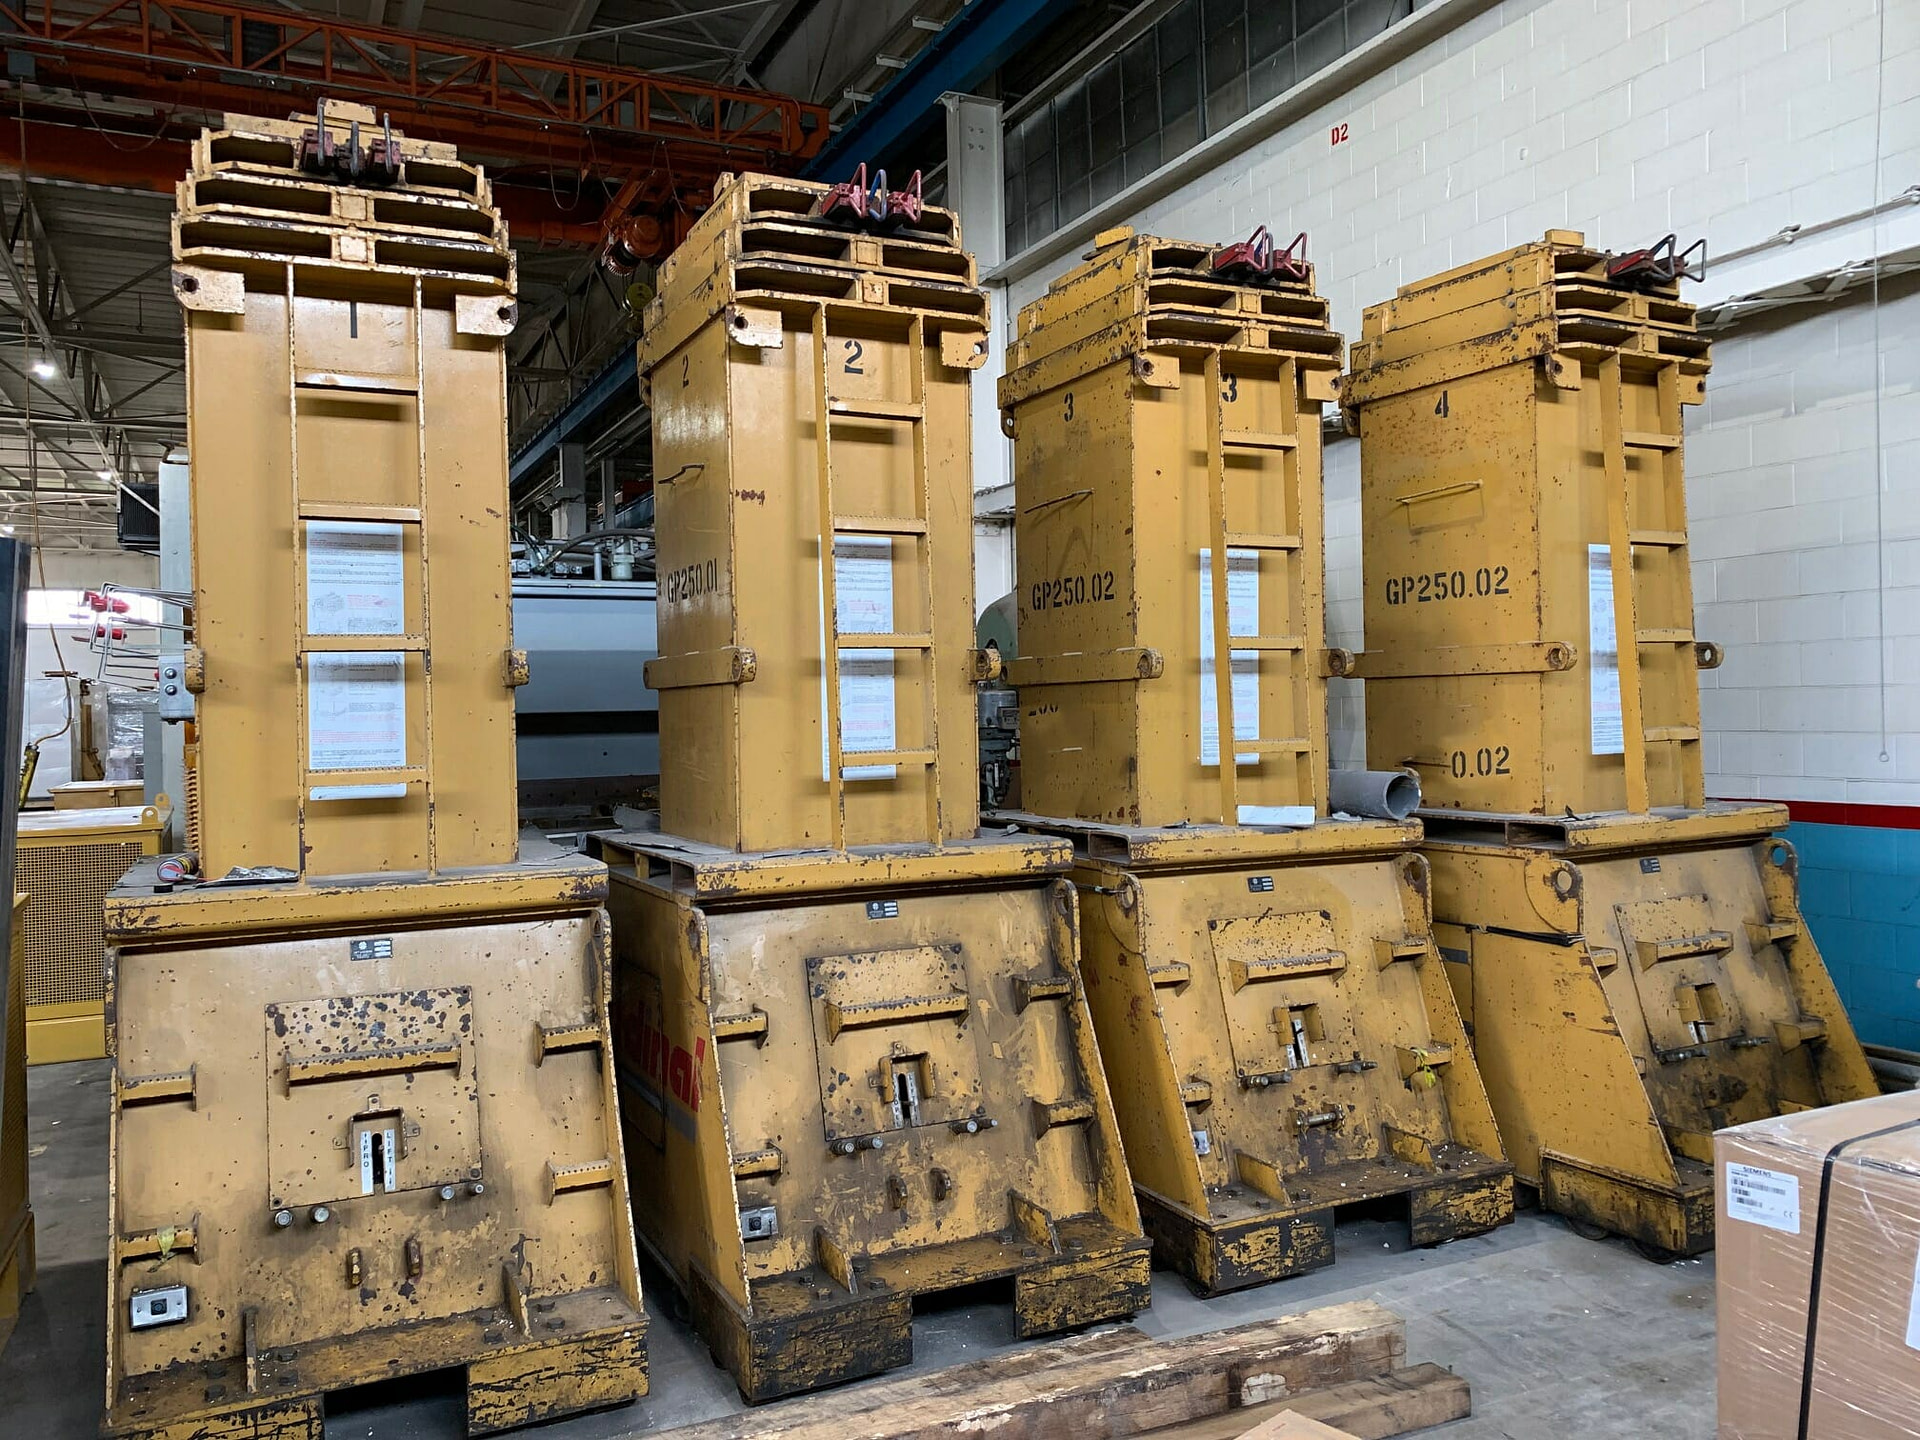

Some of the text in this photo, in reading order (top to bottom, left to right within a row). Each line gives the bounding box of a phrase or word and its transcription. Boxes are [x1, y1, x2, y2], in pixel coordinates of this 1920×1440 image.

[1331, 123, 1349, 146] D2
[682, 354, 690, 389] 2
[844, 340, 864, 375] 2
[1221, 372, 1238, 403] 3
[1434, 390, 1450, 418] 4
[1063, 392, 1075, 422] 3
[667, 557, 718, 604] GP250.01
[1031, 571, 1115, 611] GP250.02
[1386, 565, 1509, 605] GP250.02
[1452, 745, 1511, 779] 0.02
[1743, 1166, 1772, 1178] SIEMENS
